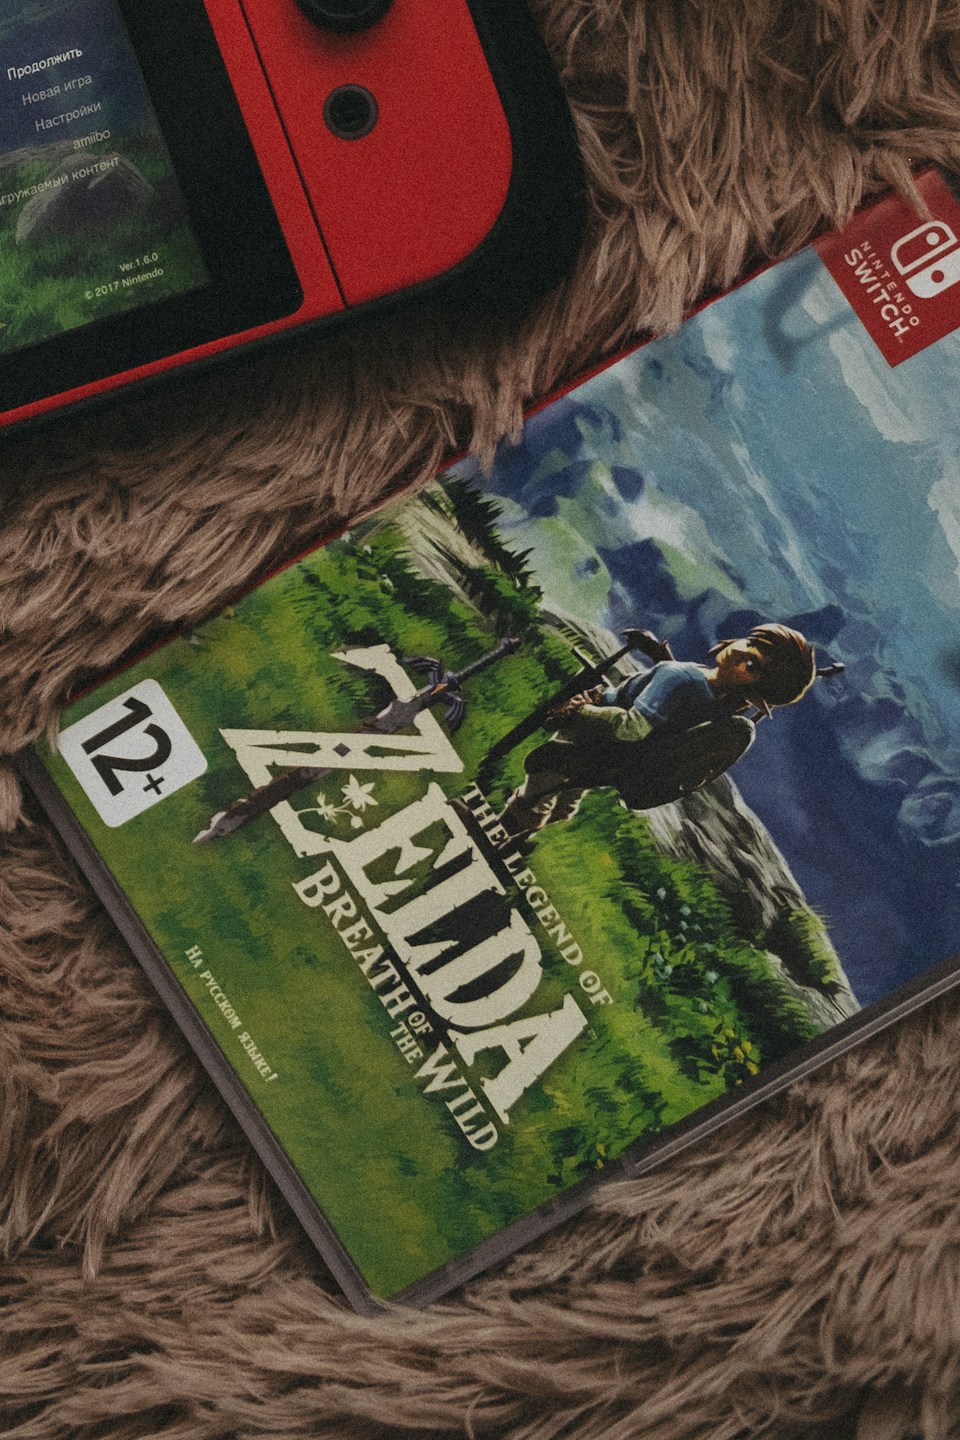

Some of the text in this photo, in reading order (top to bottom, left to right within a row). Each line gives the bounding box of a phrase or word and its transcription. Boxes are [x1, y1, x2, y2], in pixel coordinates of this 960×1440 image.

[7, 48, 83, 80] Продолжить
[21, 74, 92, 106] Новая игра
[35, 101, 102, 132] Настройки
[72, 129, 111, 150] amiibo
[72, 157, 120, 181] контент
[94, 281, 119, 297] 2017
[121, 268, 164, 288] Nintendo
[844, 248, 910, 337] SWITCH
[860, 240, 920, 327] NINTENDO
[80, 695, 173, 799] 12+
[219, 643, 591, 1126] ZELDA
[461, 781, 614, 1006] THE LEGEND OF
[184, 944, 279, 1083] НА РУССКОМ ЯЗЫКЕ!
[290, 861, 499, 1151] BREATH OF THE WILD
